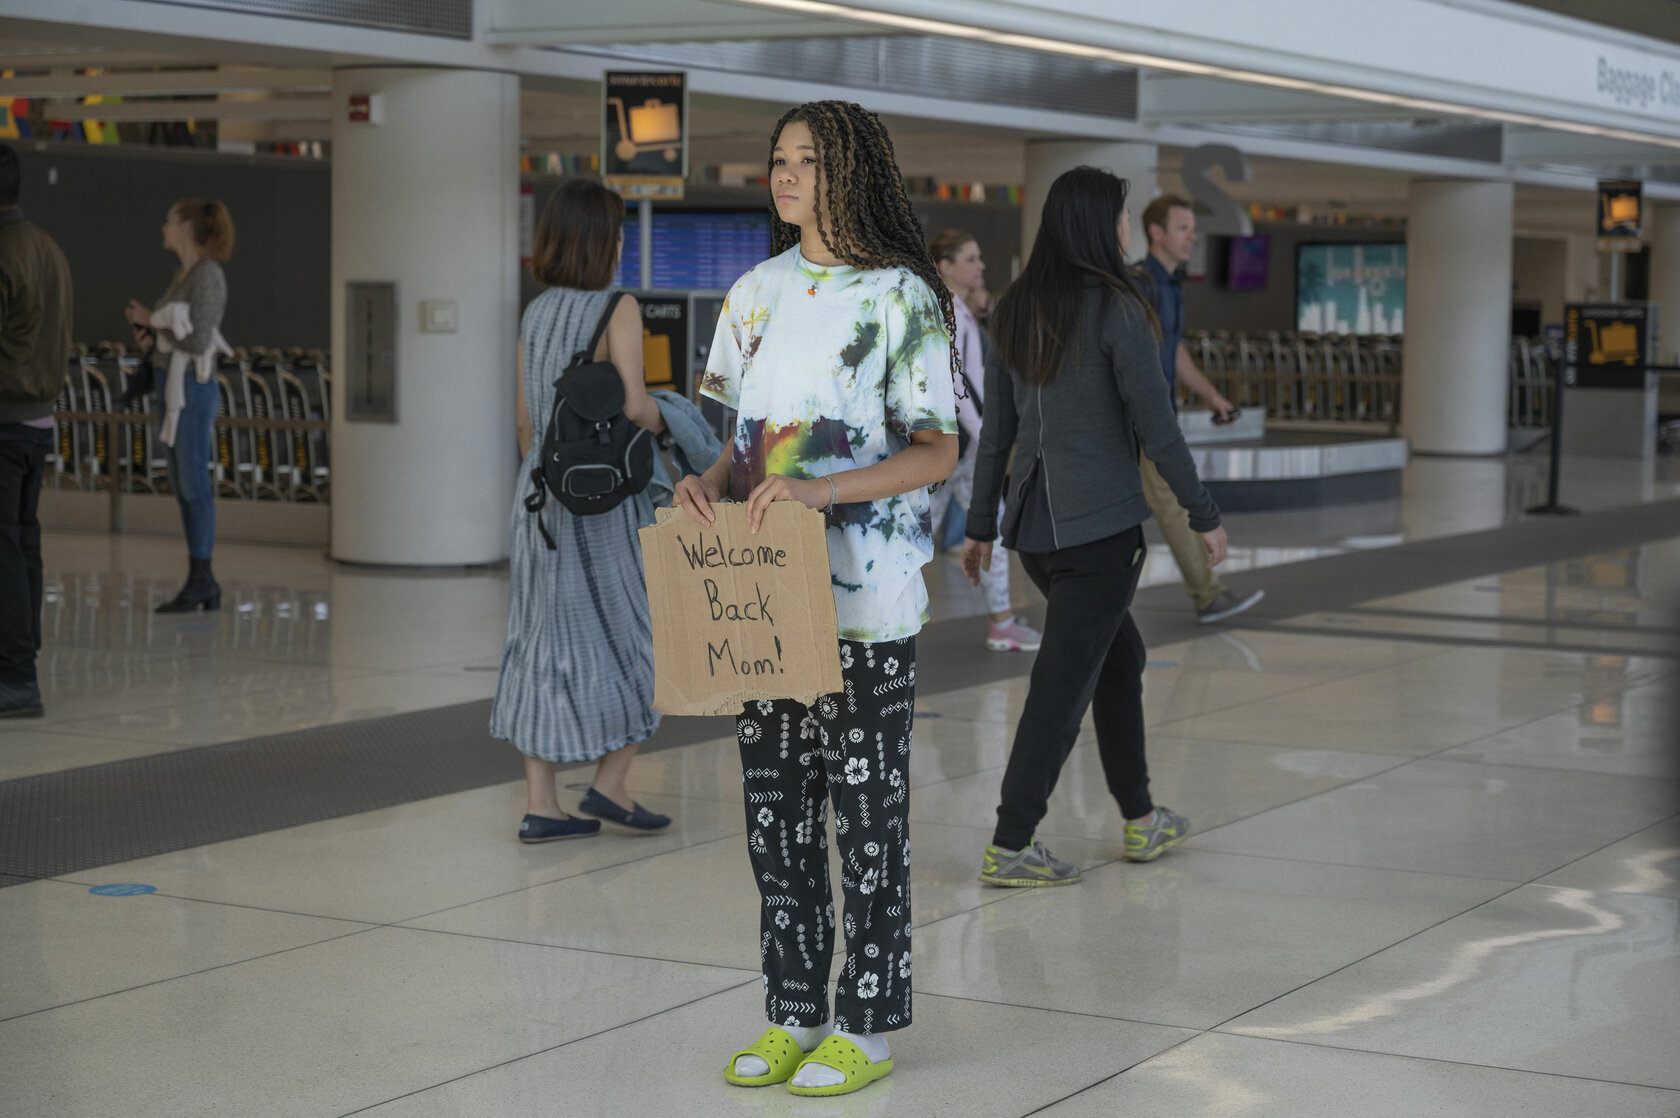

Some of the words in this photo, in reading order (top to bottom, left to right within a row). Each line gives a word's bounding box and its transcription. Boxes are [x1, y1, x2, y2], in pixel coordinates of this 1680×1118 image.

[1597, 56, 1656, 108] Baggage
[645, 303, 682, 319] CARTS
[676, 531, 787, 570] Welcome
[703, 578, 775, 627] Back
[707, 635, 785, 677] Mom!
